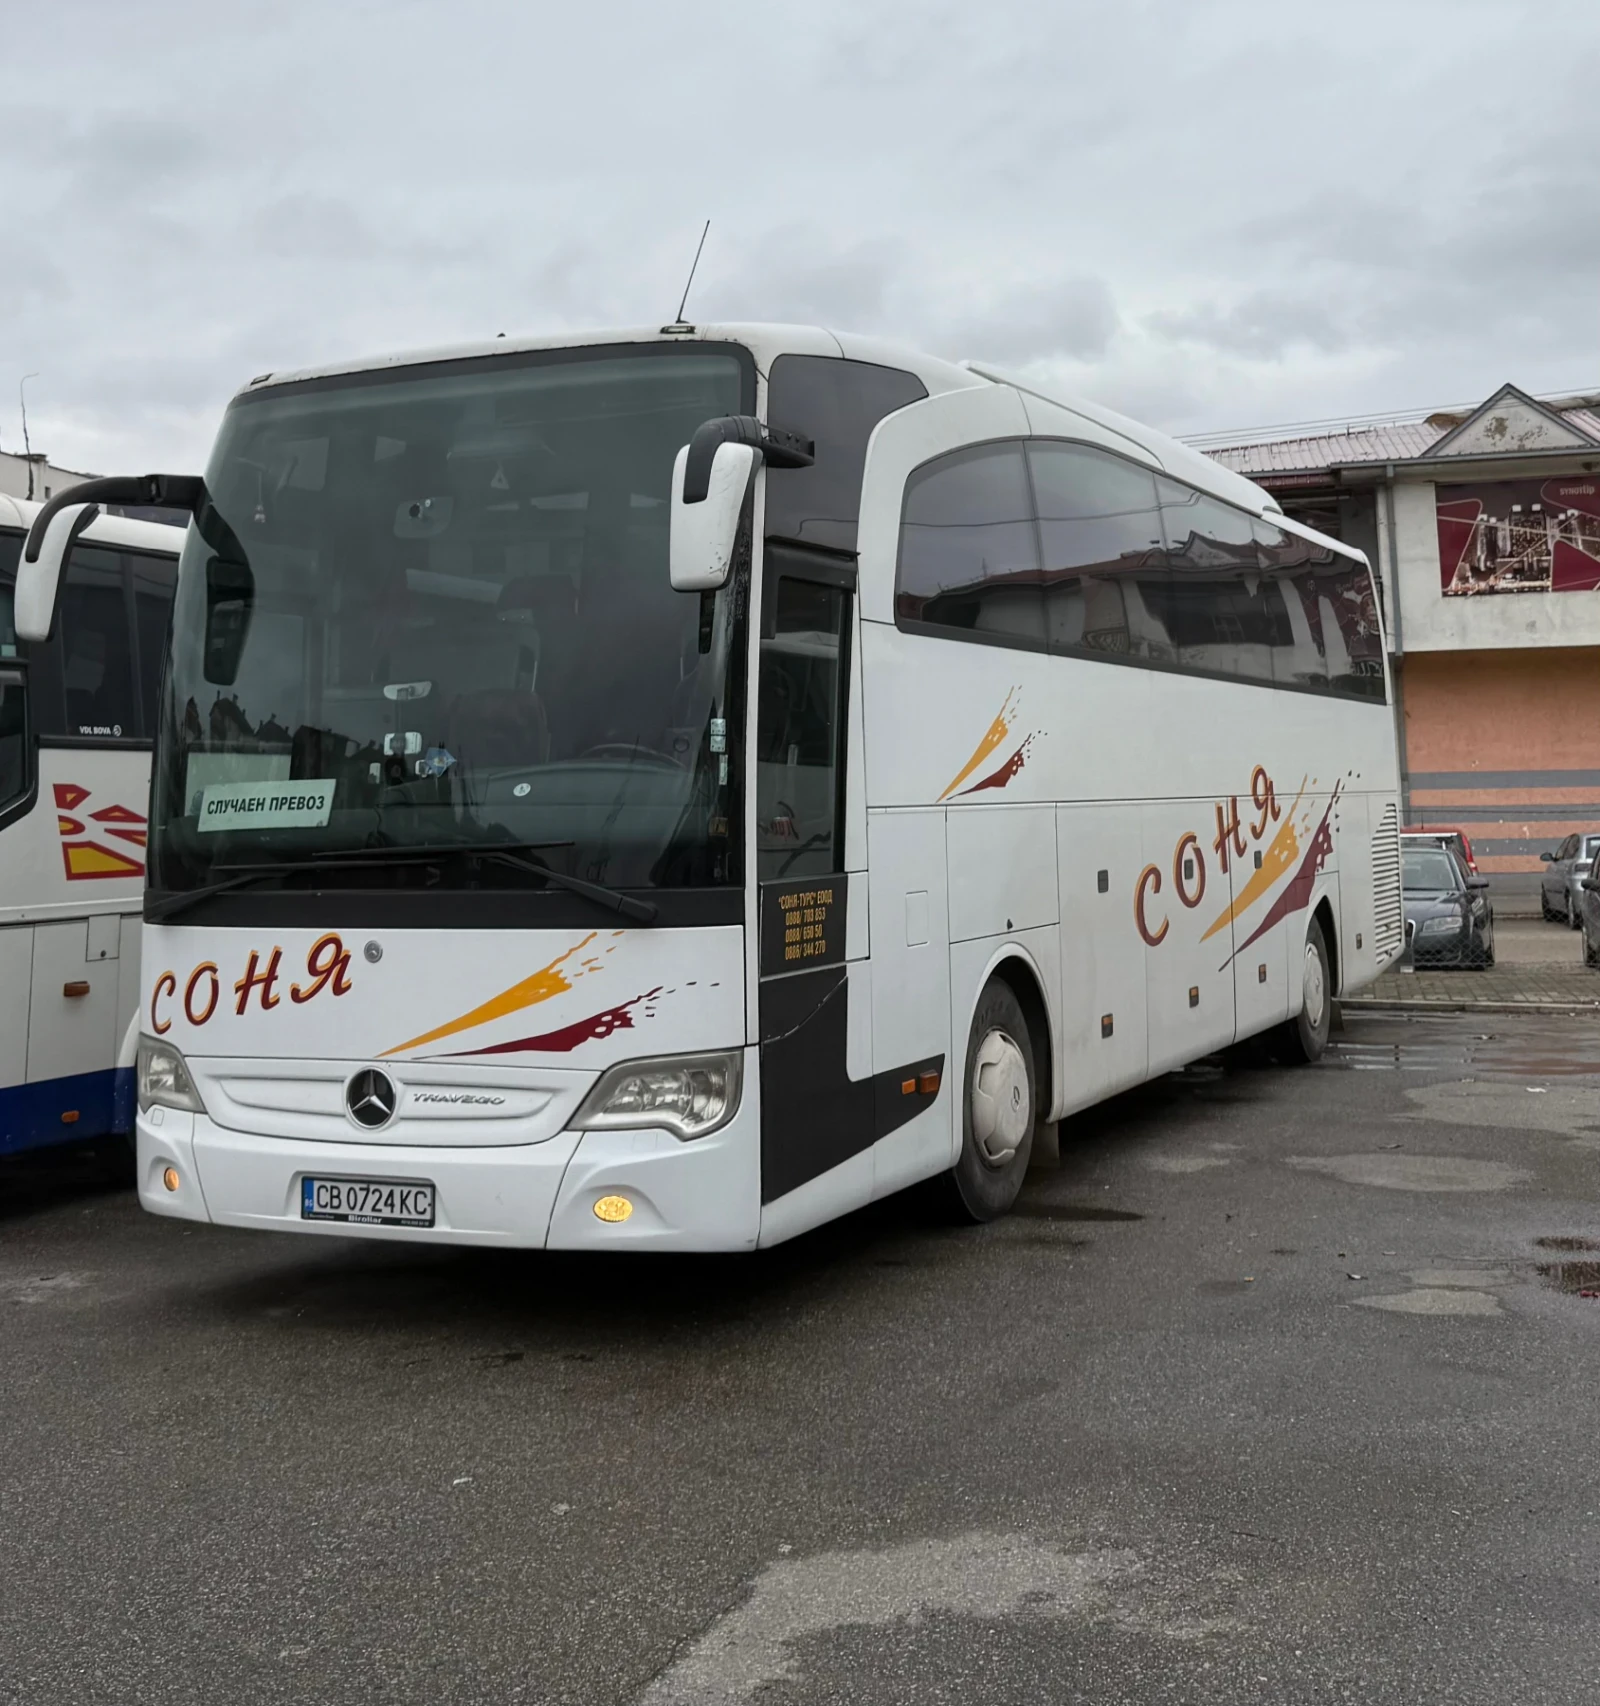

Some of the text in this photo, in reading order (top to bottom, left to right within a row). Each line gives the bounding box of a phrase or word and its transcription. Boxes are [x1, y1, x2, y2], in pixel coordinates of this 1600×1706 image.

[79, 725, 111, 735] VDL BOVA
[207, 795, 325, 815] СЛУЧАЕН ПРЕВОЗ
[1134, 764, 1281, 947] СОНЯ
[815, 940, 826, 955] 270
[151, 931, 352, 1034] СОНЯ
[413, 1092, 506, 1105] TRAVEGO
